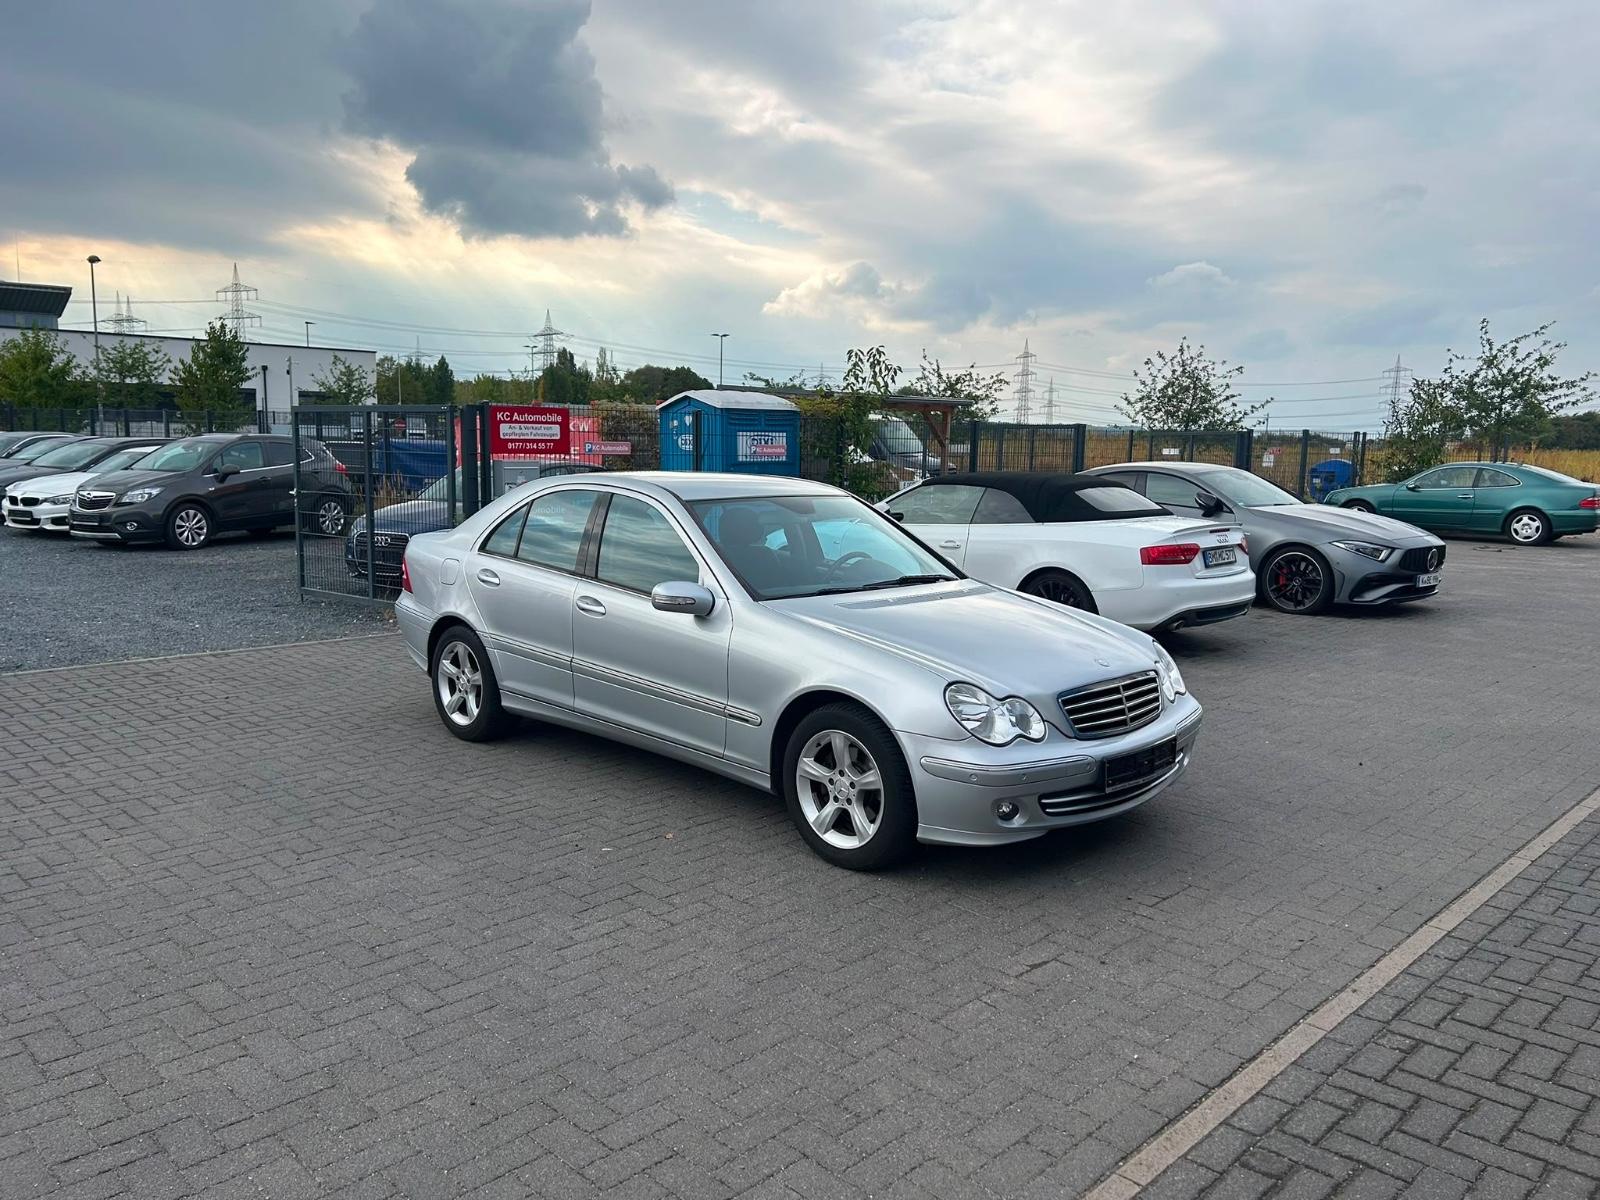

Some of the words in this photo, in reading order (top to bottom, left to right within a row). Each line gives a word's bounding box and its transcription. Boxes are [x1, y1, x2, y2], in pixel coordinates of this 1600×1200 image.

[496, 411, 511, 421] KC
[512, 412, 562, 423] Automobile
[585, 443, 592, 452] P
